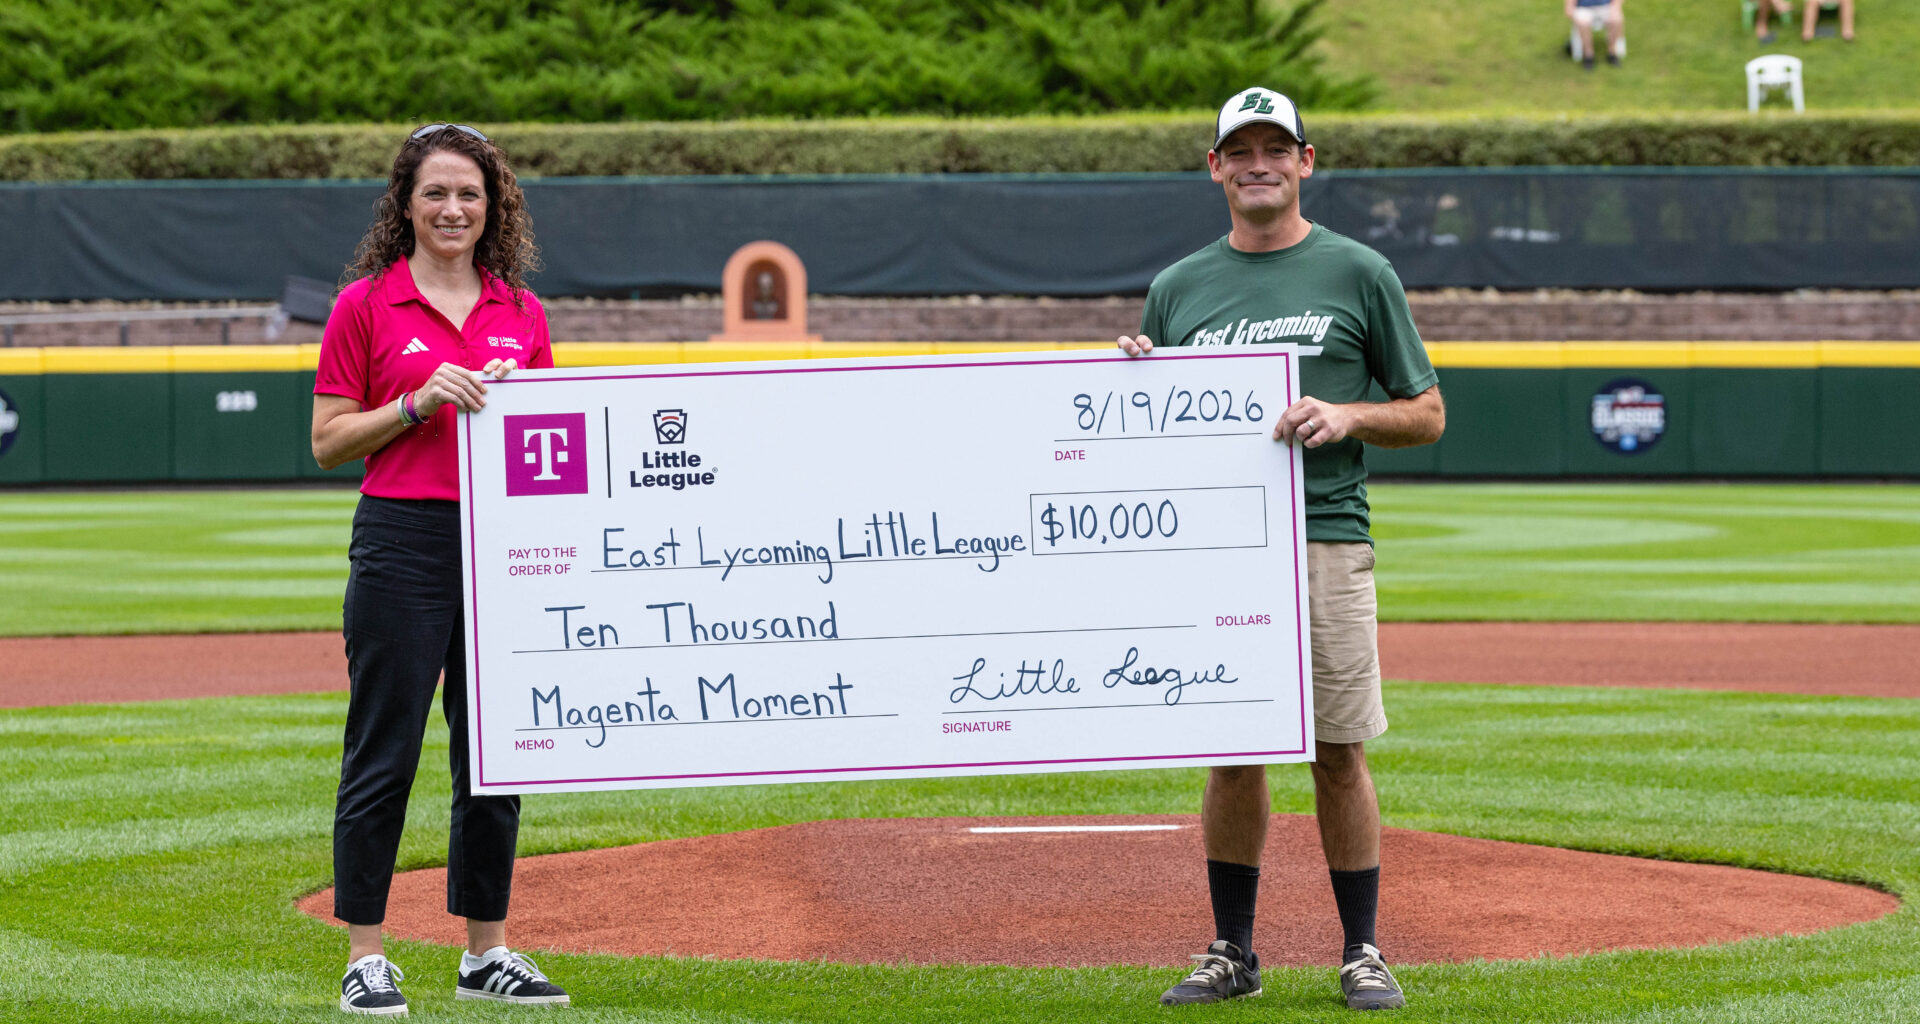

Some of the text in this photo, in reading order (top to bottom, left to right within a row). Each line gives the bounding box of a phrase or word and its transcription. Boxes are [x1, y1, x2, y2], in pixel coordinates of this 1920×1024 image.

[1238, 92, 1275, 114] EL
[1191, 310, 1333, 346] East Lycoming
[1073, 385, 1264, 434] 8/19/2026
[642, 450, 702, 469] Little
[1055, 450, 1086, 461] DATE
[1040, 498, 1179, 547] $10,000
[508, 547, 577, 559] PAY TO THE
[603, 510, 1027, 584] East Lycoming Little League
[508, 563, 571, 576] ORDER OF
[544, 600, 839, 649] Ten Thousand
[1215, 614, 1272, 627] DOLLARS
[949, 646, 1239, 706] Little League
[531, 672, 854, 748] Magenta Moment
[942, 720, 1012, 734] SIGNATURE
[514, 739, 555, 751] MEMO
